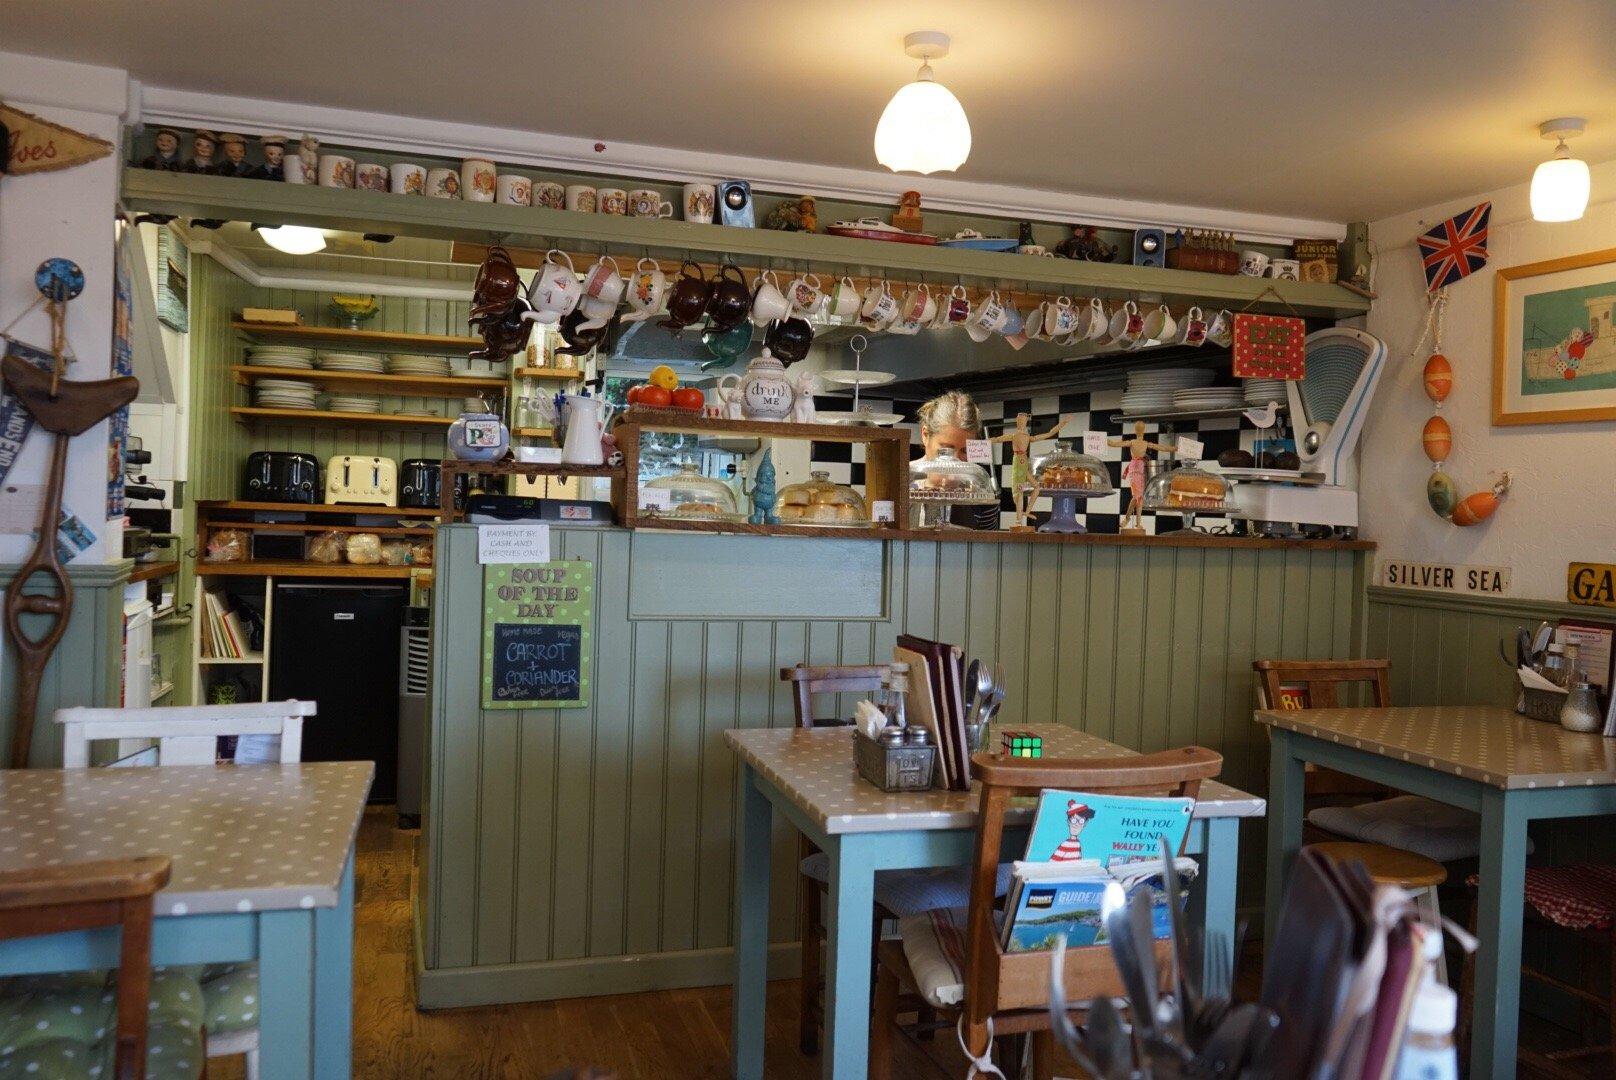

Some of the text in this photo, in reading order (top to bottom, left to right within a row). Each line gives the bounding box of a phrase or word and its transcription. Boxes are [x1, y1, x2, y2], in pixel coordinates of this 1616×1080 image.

[1294, 245, 1336, 254] JUNIOR
[763, 397, 780, 406] ME
[486, 529, 537, 538] PAYMENT BY
[490, 540, 533, 548] CASH AND
[522, 549, 544, 557] ONLY
[511, 567, 566, 583] SOUP
[1389, 564, 1502, 592] SILVER SEA
[497, 585, 579, 601] OF THE
[517, 603, 559, 617] DAY
[506, 642, 572, 662] CARROT
[505, 668, 580, 687] CORIANDER
[1121, 817, 1175, 829] HAVE YOU
[1124, 830, 1163, 840] FOUND
[1112, 841, 1145, 852] WALLY
